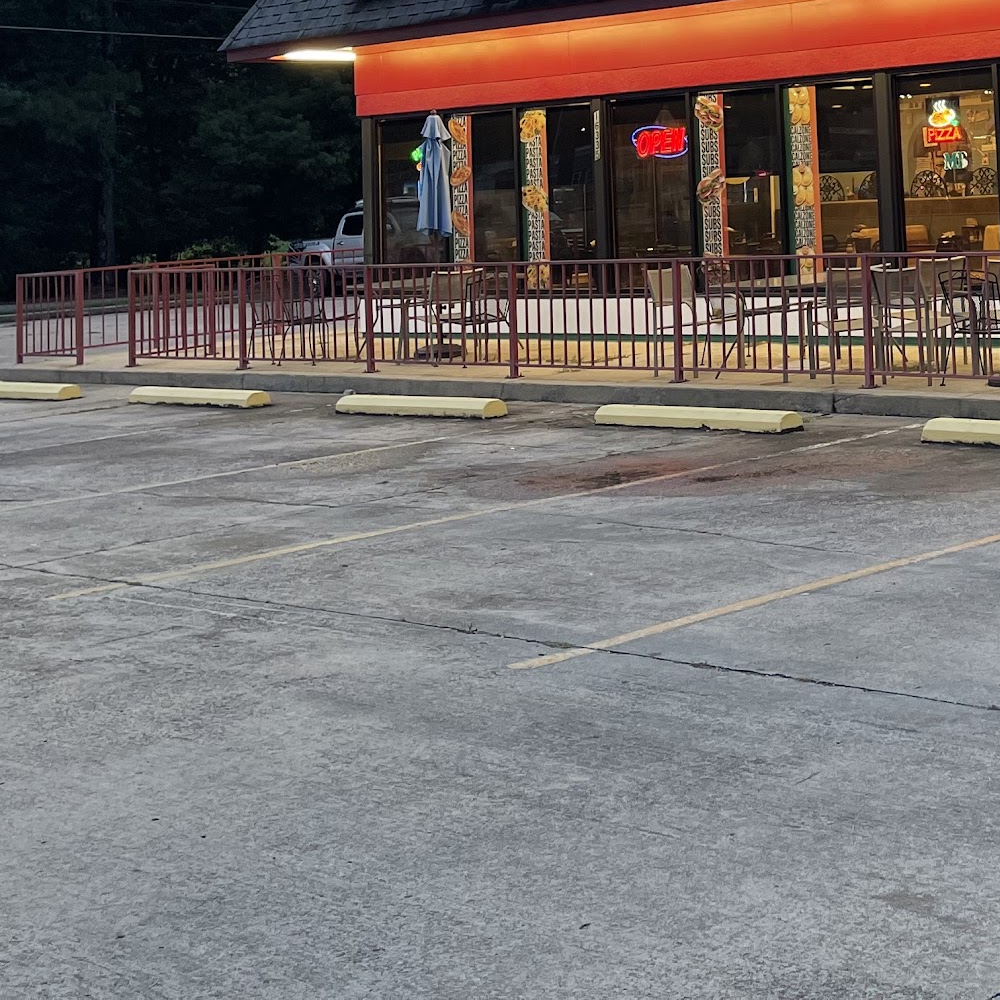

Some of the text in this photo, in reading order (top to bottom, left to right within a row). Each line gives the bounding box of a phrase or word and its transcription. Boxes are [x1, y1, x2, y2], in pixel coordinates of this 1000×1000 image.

[700, 128, 718, 140] SUBS
[927, 126, 962, 142] PIZZA
[636, 126, 686, 158] OPEN
[701, 141, 718, 153] SUBS
[526, 147, 541, 158] PASTA
[526, 157, 542, 168] PASTA
[702, 153, 719, 166] SUBS
[526, 168, 542, 179] PASTA
[704, 205, 720, 218] SUBS
[528, 219, 544, 230] PASTA
[704, 218, 721, 230] SUBS
[528, 229, 544, 240] PASTA
[705, 230, 721, 242] SUBS
[528, 240, 545, 251] PASTA
